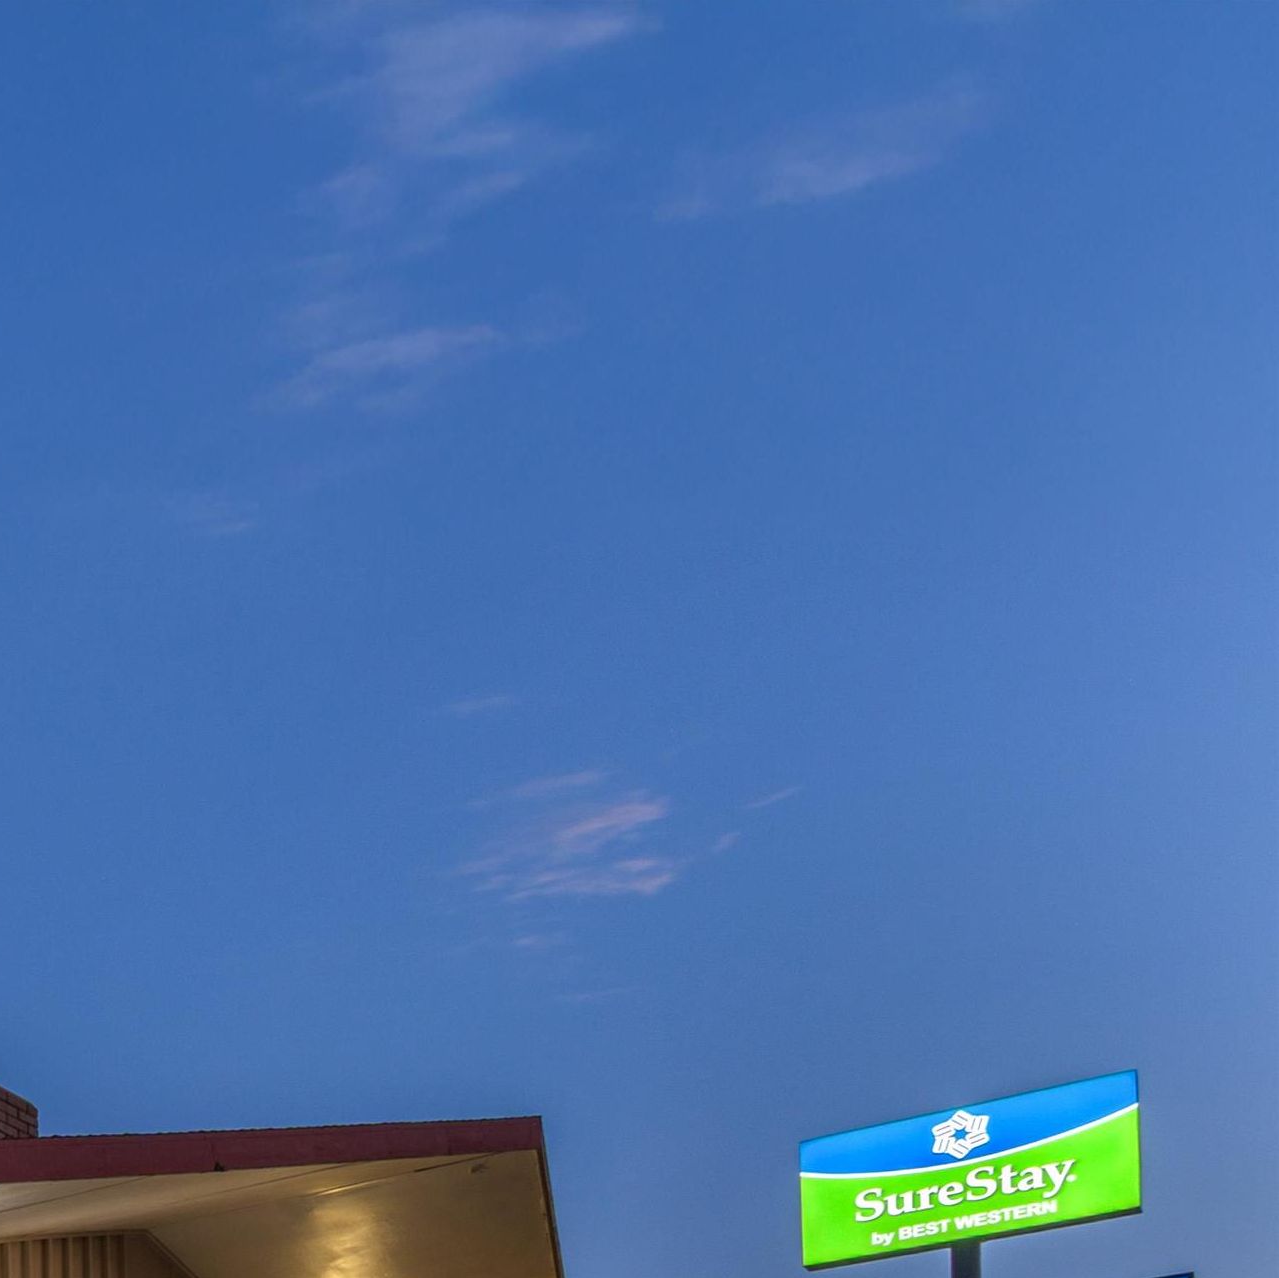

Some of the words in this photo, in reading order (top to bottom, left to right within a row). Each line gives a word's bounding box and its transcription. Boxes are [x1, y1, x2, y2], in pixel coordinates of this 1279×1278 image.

[871, 1231, 895, 1246] by
[898, 1218, 951, 1241] BEST
[953, 1200, 1058, 1230] WESTERN
